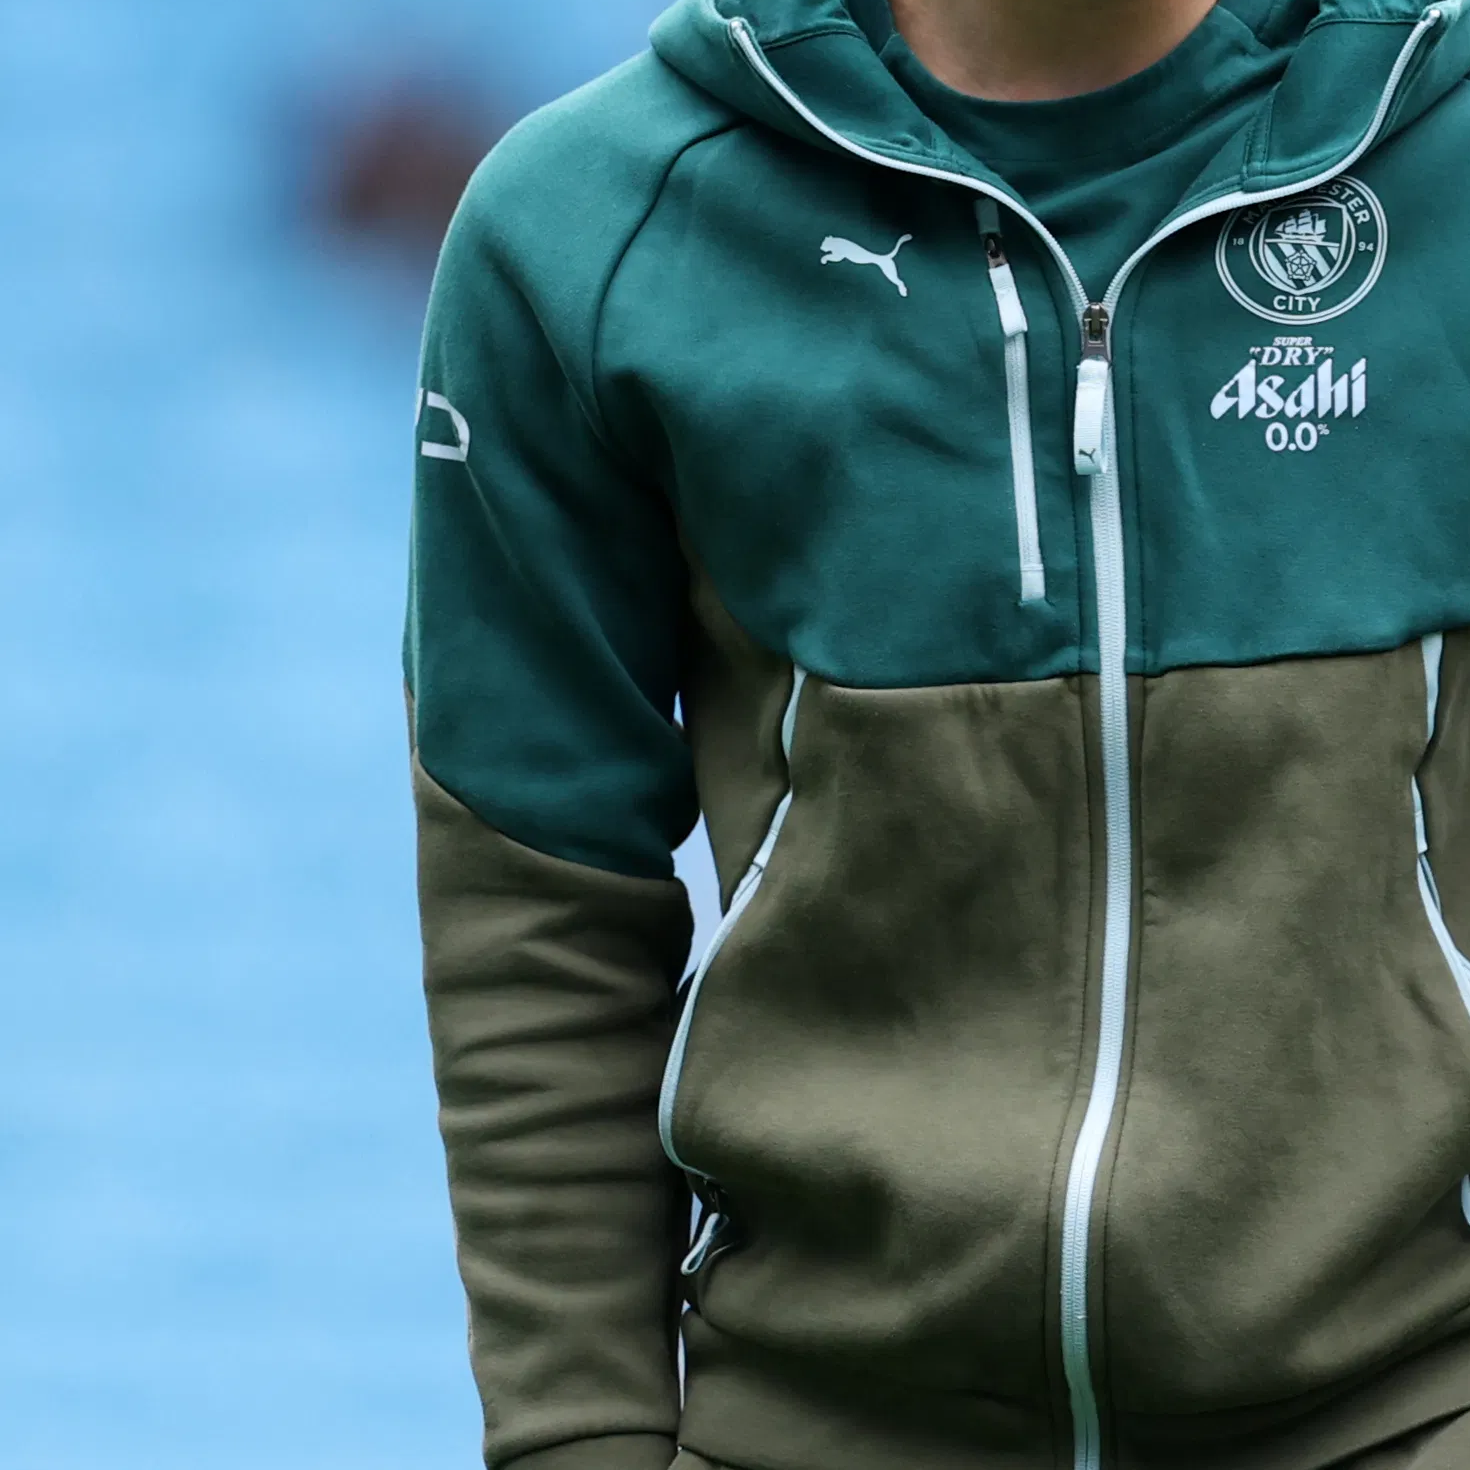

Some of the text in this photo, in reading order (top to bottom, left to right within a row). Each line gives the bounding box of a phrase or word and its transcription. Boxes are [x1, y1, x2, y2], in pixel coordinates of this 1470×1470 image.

[1232, 237, 1375, 252] 18 94
[1273, 295, 1321, 312] CITY
[1272, 336, 1313, 346] SUPER
[1210, 358, 1367, 419] Asahi
[1265, 421, 1330, 452] 0.0%
